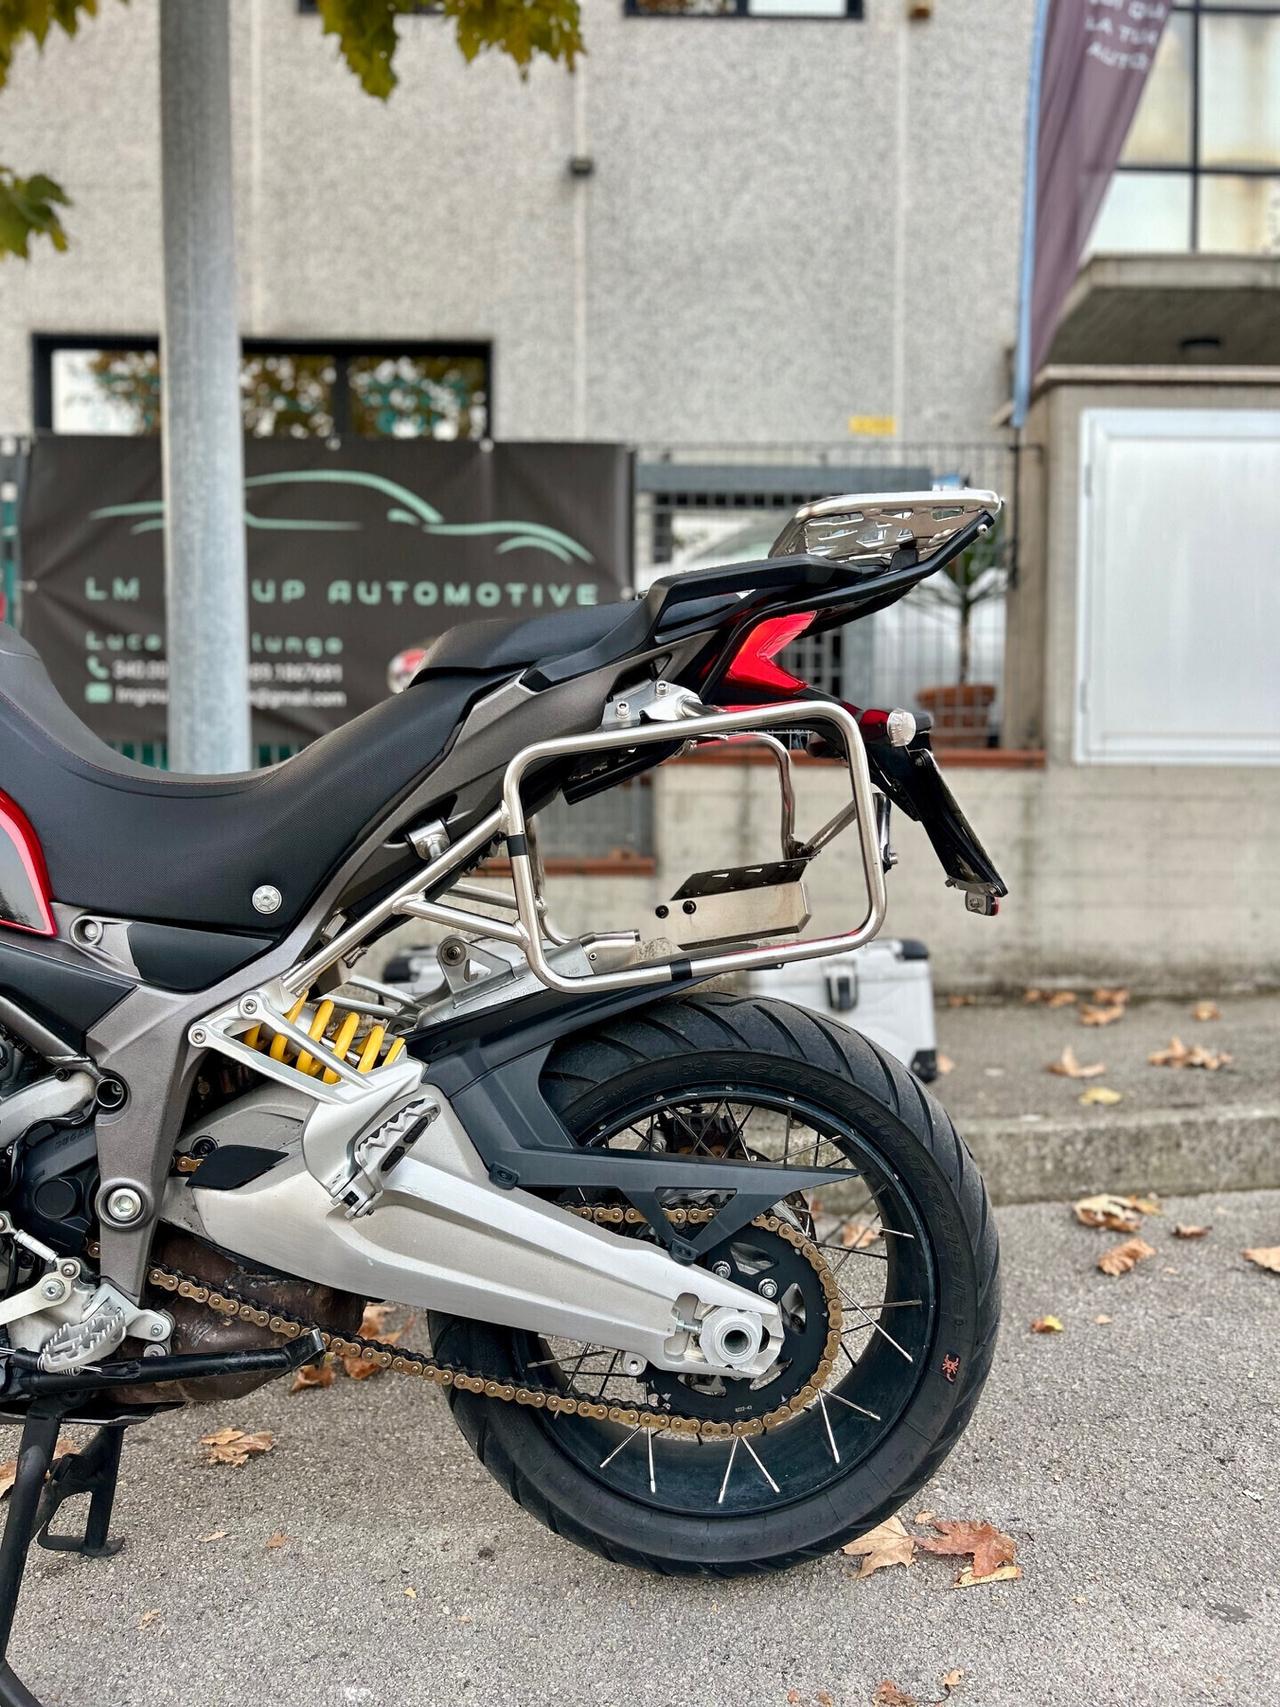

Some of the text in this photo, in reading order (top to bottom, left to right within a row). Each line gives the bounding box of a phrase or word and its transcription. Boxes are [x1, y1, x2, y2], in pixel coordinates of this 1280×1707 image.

[1086, 17, 1159, 46] LA TUA
[1087, 41, 1148, 70] AUTO
[85, 577, 140, 601] LM
[327, 580, 599, 608] AUTOMOTIVE
[715, 1058, 912, 1149] SCORPION
